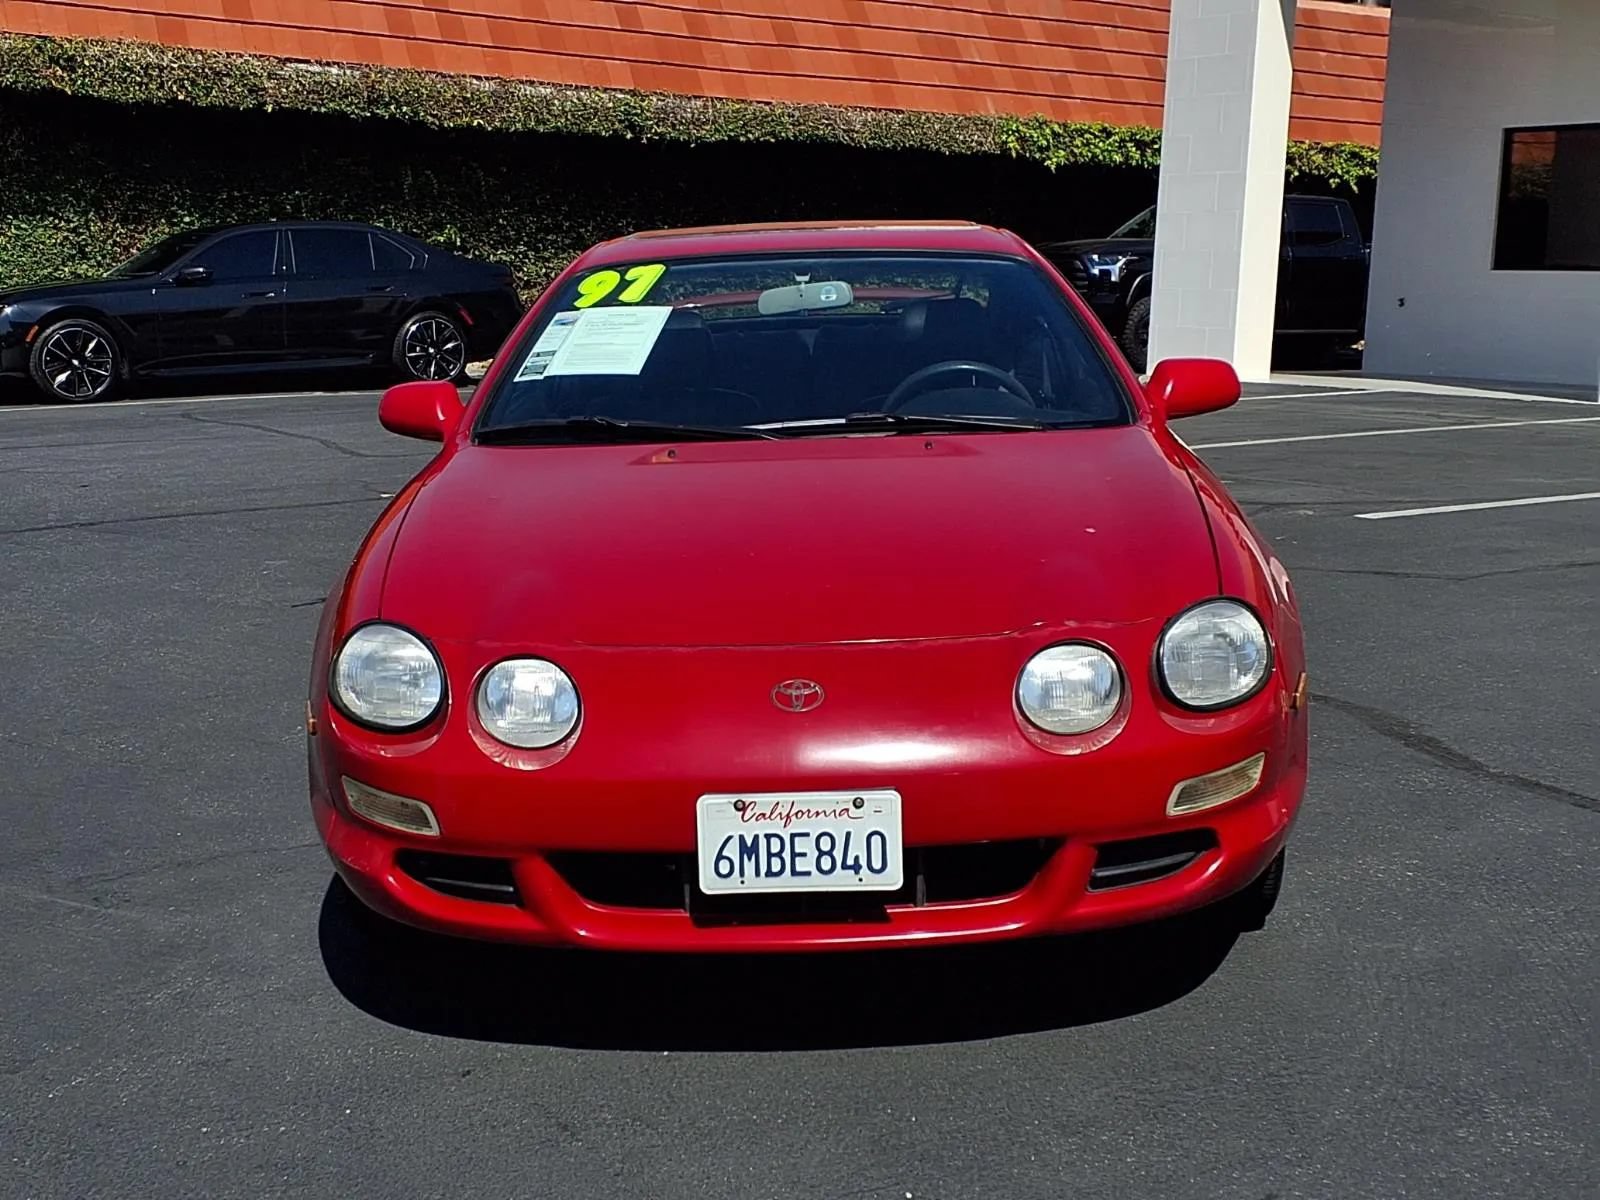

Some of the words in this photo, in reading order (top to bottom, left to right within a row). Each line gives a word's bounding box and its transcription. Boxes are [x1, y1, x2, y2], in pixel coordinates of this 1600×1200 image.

[574, 264, 666, 308] 97
[740, 800, 864, 828] California
[714, 830, 888, 879] 6MBE840
